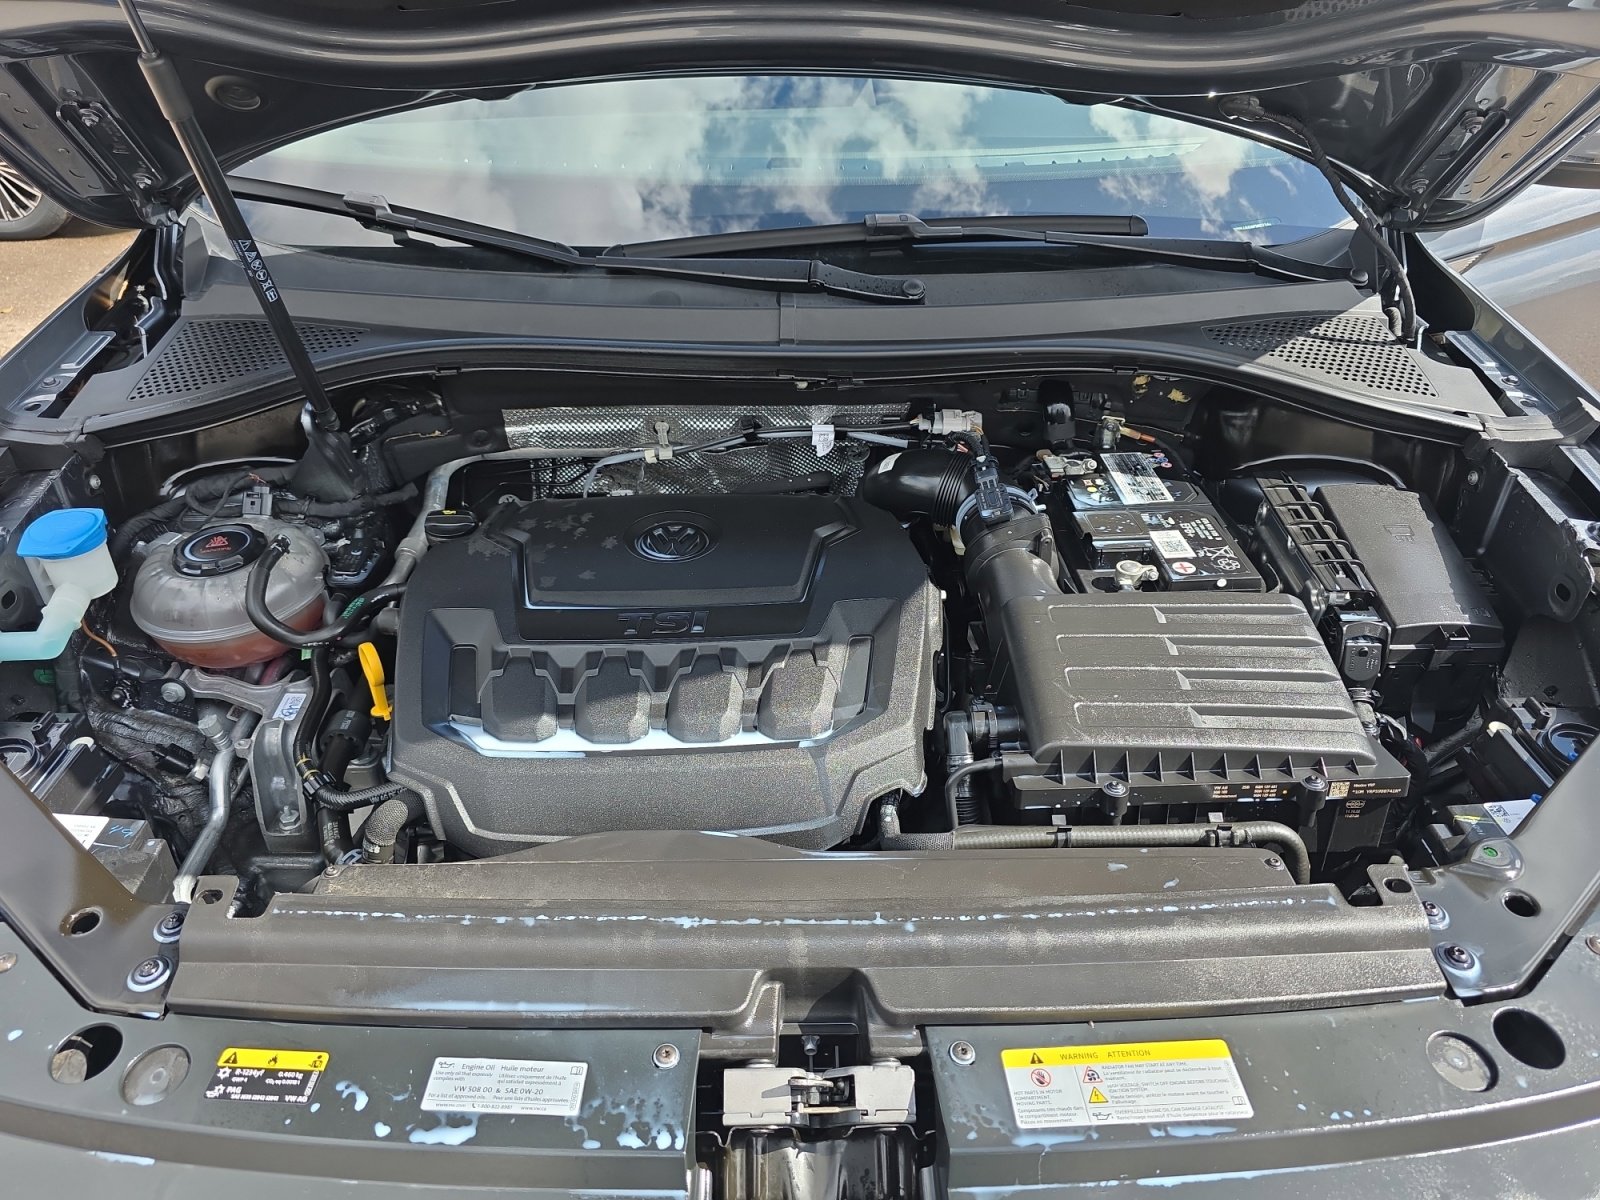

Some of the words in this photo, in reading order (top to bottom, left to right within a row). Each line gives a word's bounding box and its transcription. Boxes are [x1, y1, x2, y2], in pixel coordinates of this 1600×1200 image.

[618, 611, 709, 635] TSI
[1060, 1052, 1098, 1060] WARNING
[1108, 1049, 1151, 1058] ATTENTION
[235, 1068, 265, 1078] R-1234yf
[226, 1086, 242, 1094] PAG
